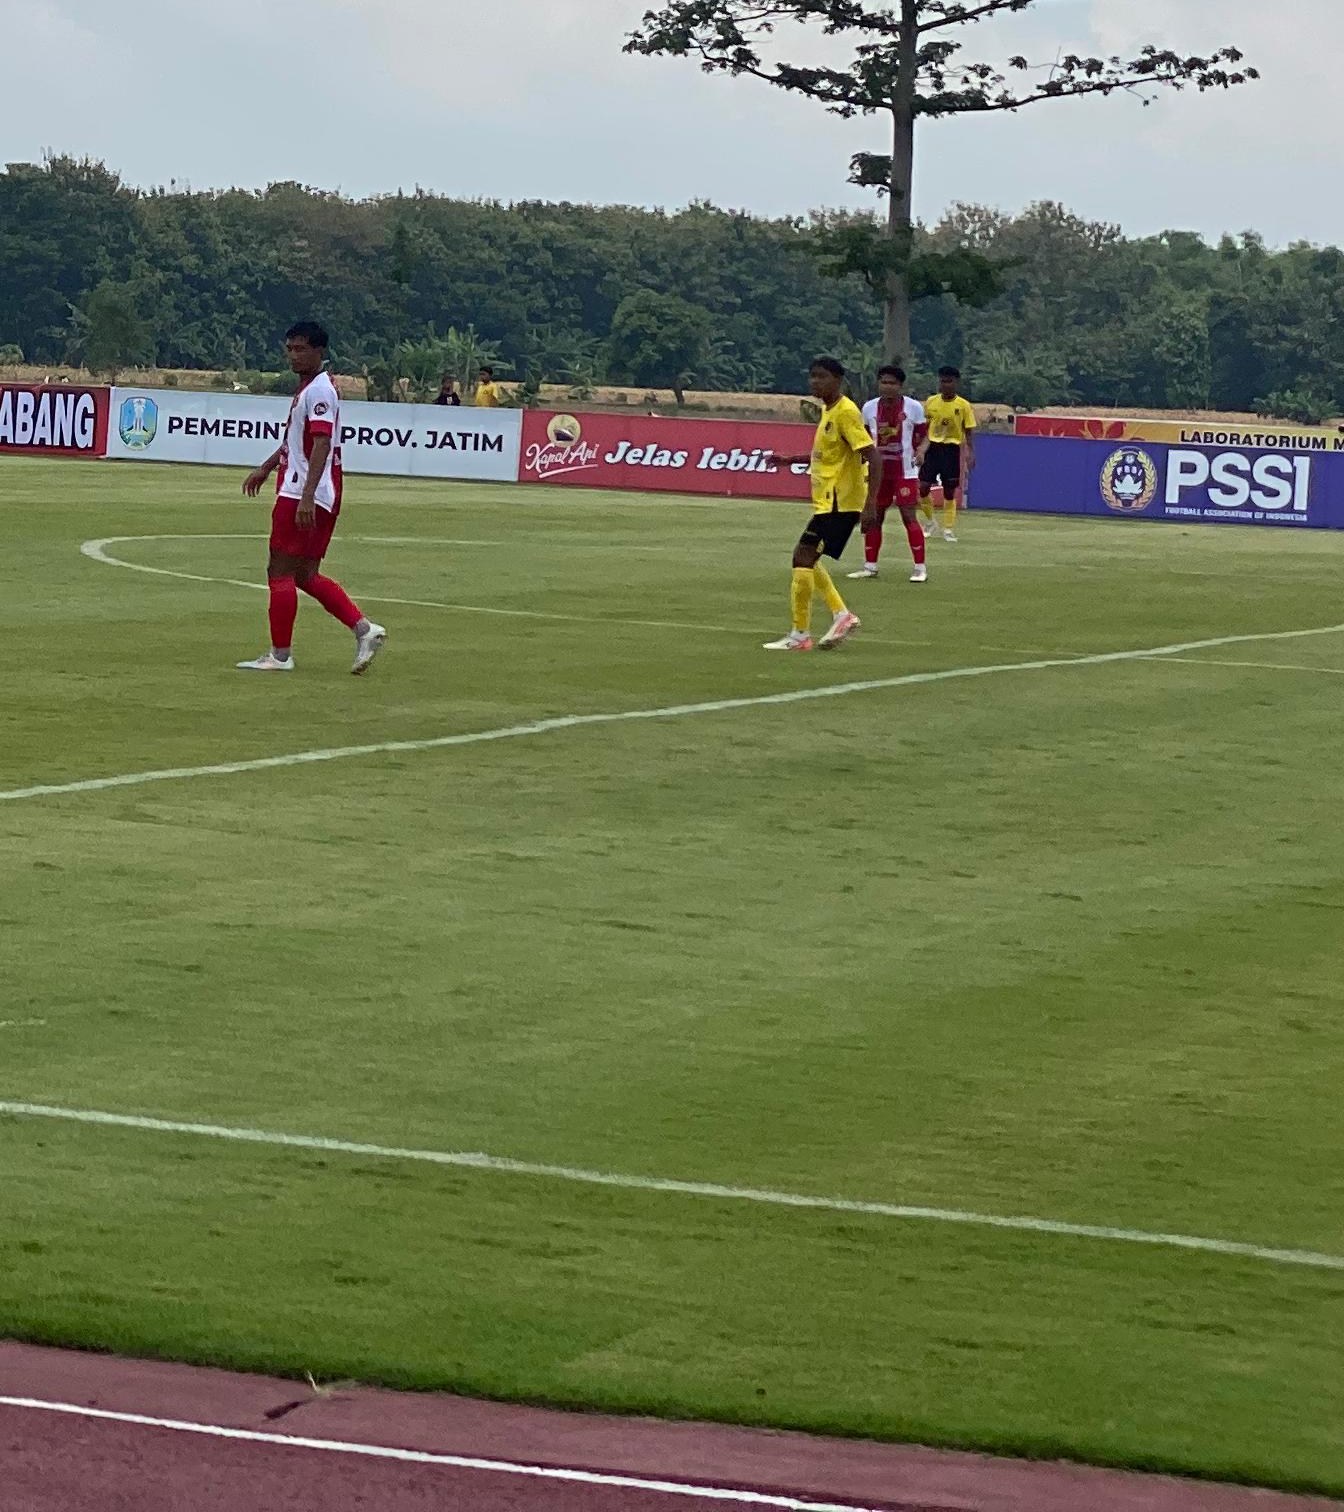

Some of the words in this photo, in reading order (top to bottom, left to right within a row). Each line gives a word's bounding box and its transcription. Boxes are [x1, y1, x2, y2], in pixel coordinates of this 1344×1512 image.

[340, 426, 417, 448] PROV.
[424, 431, 504, 452] JATIM
[1180, 430, 1326, 449] LABORATORIUM
[525, 443, 568, 470] Kapal
[567, 441, 600, 465] Api
[604, 441, 688, 467] Jelas
[1165, 449, 1310, 511] PSSI
